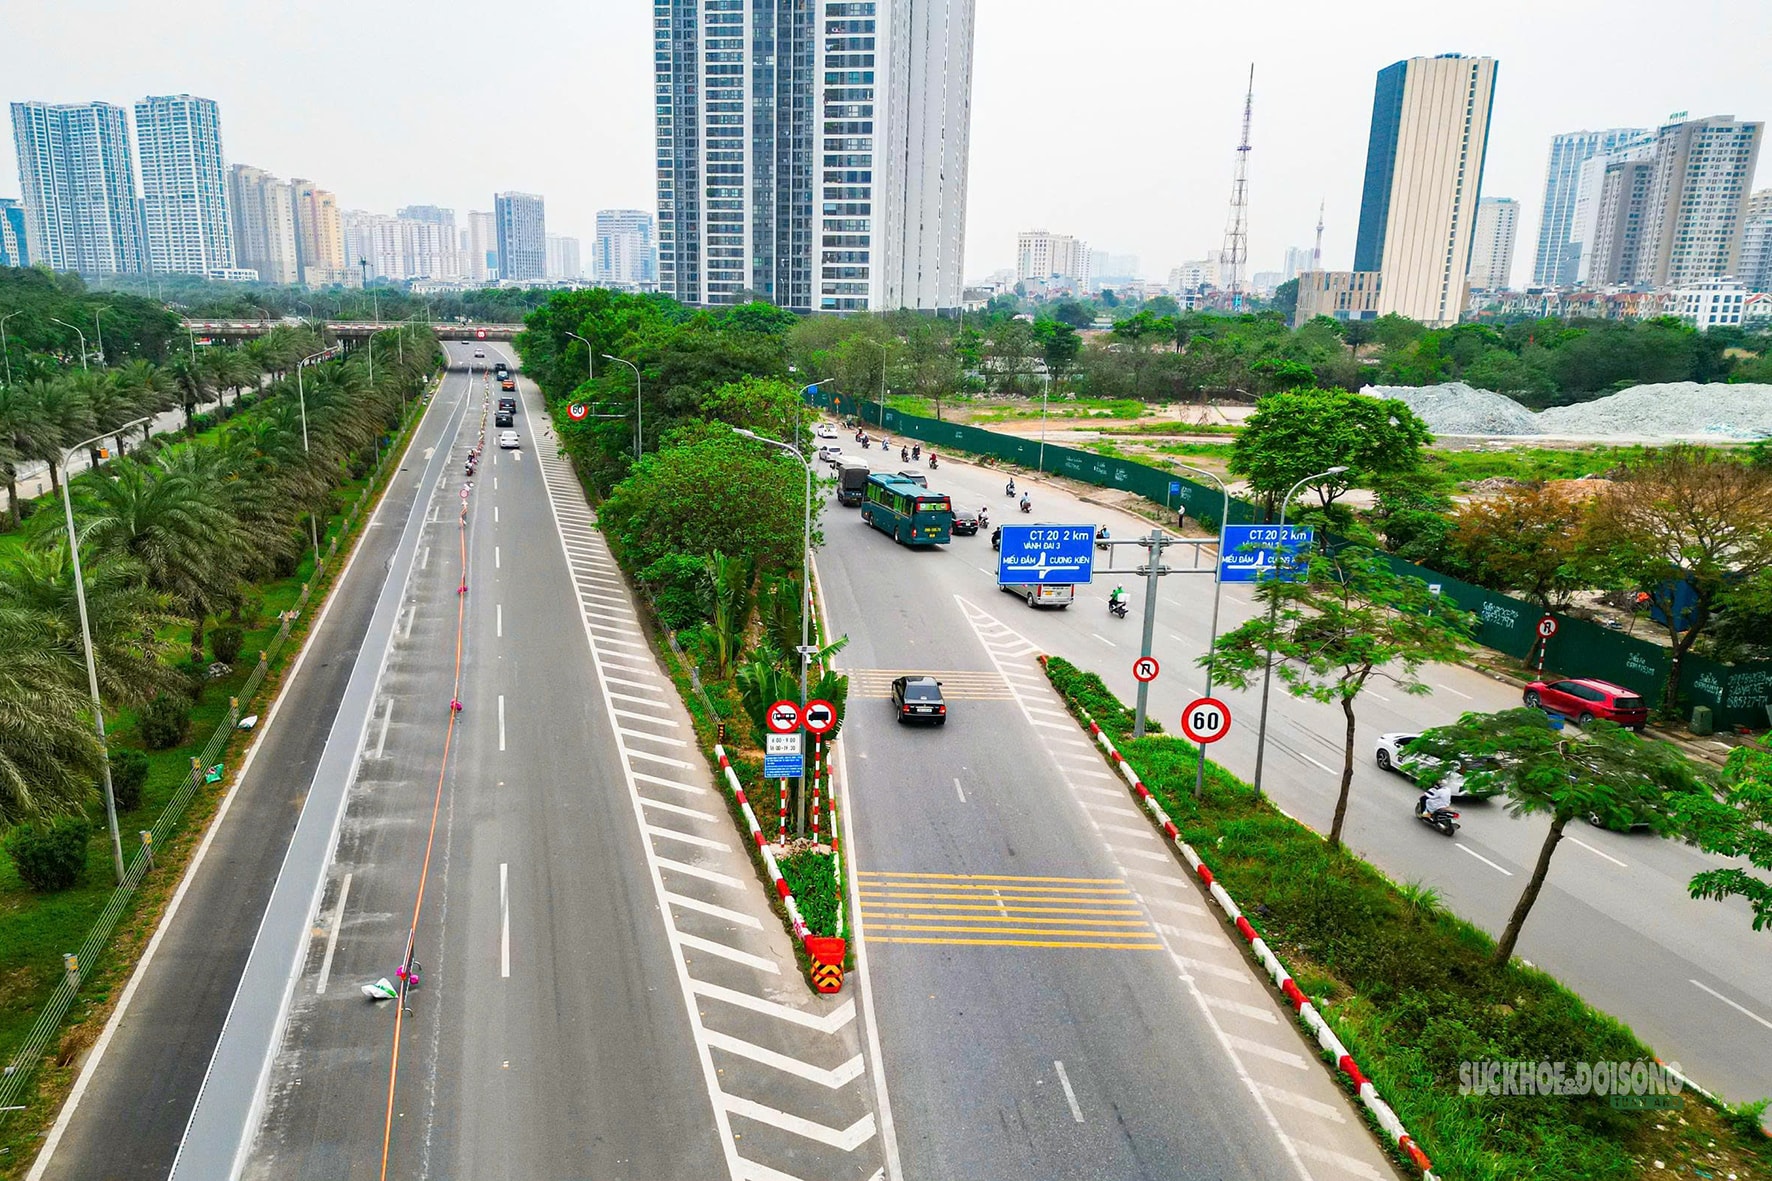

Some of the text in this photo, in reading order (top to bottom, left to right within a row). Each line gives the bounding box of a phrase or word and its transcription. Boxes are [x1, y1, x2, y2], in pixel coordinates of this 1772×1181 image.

[572, 405, 583, 415] 60
[1063, 530, 1070, 540] 2
[1072, 530, 1089, 540] km
[1281, 529, 1288, 540] 2
[1290, 529, 1306, 540] km
[1055, 542, 1061, 550] 3
[1193, 711, 1219, 730] 60
